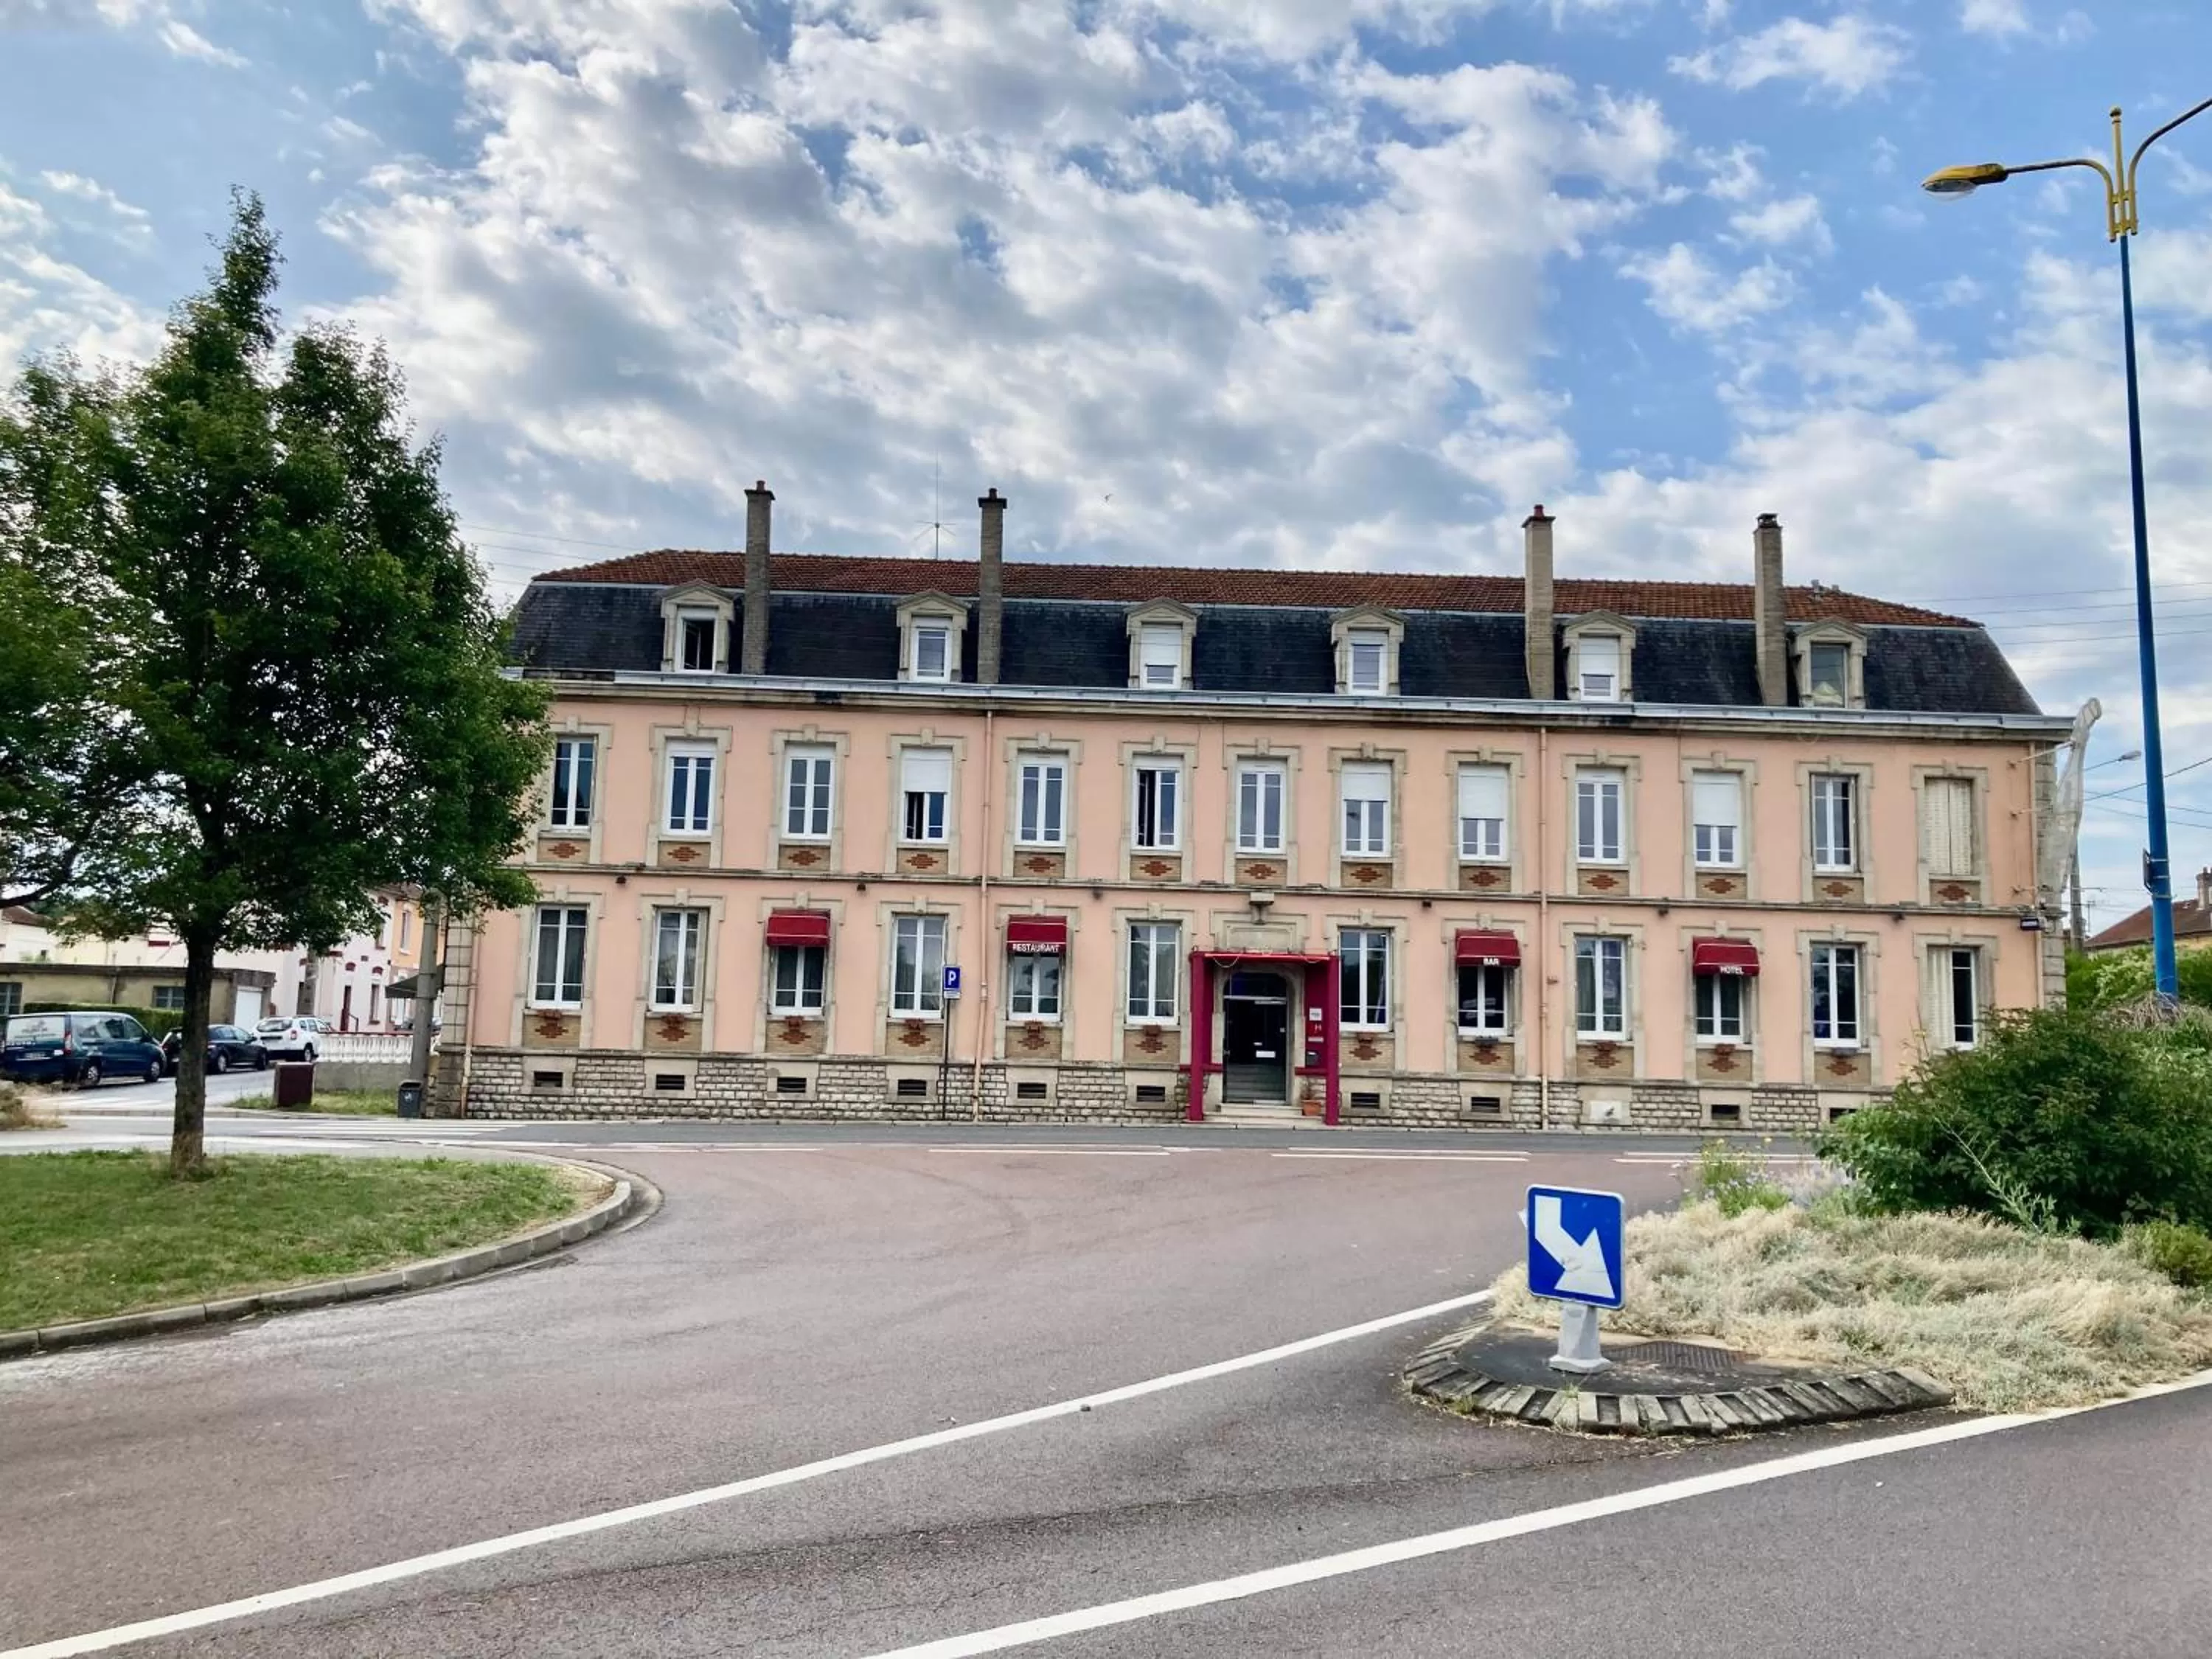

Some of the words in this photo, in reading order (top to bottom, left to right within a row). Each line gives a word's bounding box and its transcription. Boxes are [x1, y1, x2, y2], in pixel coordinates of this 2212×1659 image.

[1012, 943, 1060, 953] RESTAURANT
[1483, 958, 1500, 966] BAR
[1719, 966, 1745, 975] HOTEL
[947, 970, 956, 986] P
